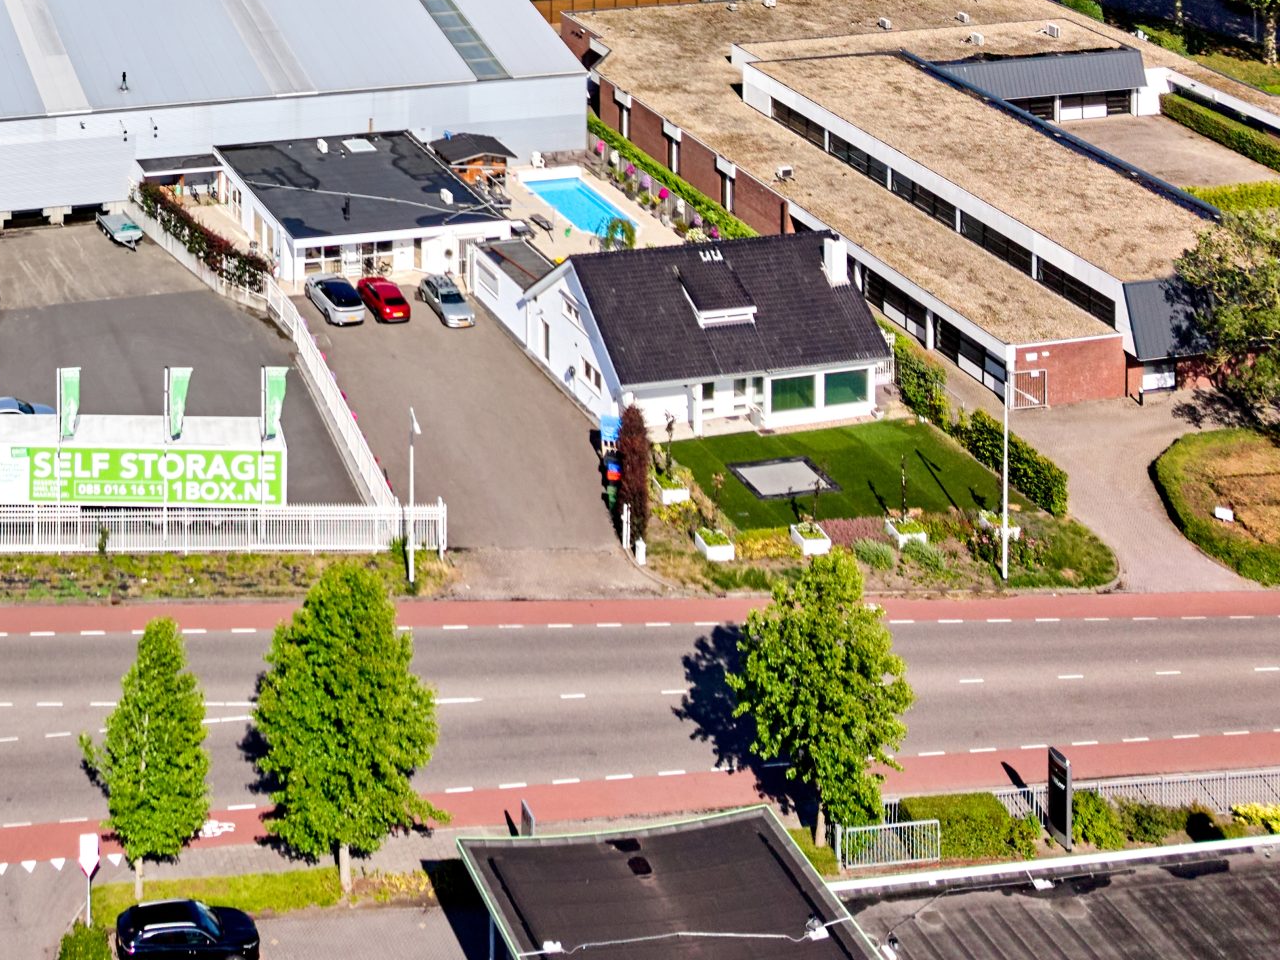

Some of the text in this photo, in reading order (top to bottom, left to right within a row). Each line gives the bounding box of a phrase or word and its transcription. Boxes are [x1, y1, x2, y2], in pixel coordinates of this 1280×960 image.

[33, 451, 110, 478] SELF
[120, 453, 276, 480] STORAGE
[149, 484, 163, 496] 11
[172, 481, 276, 501] 1BOX.NL
